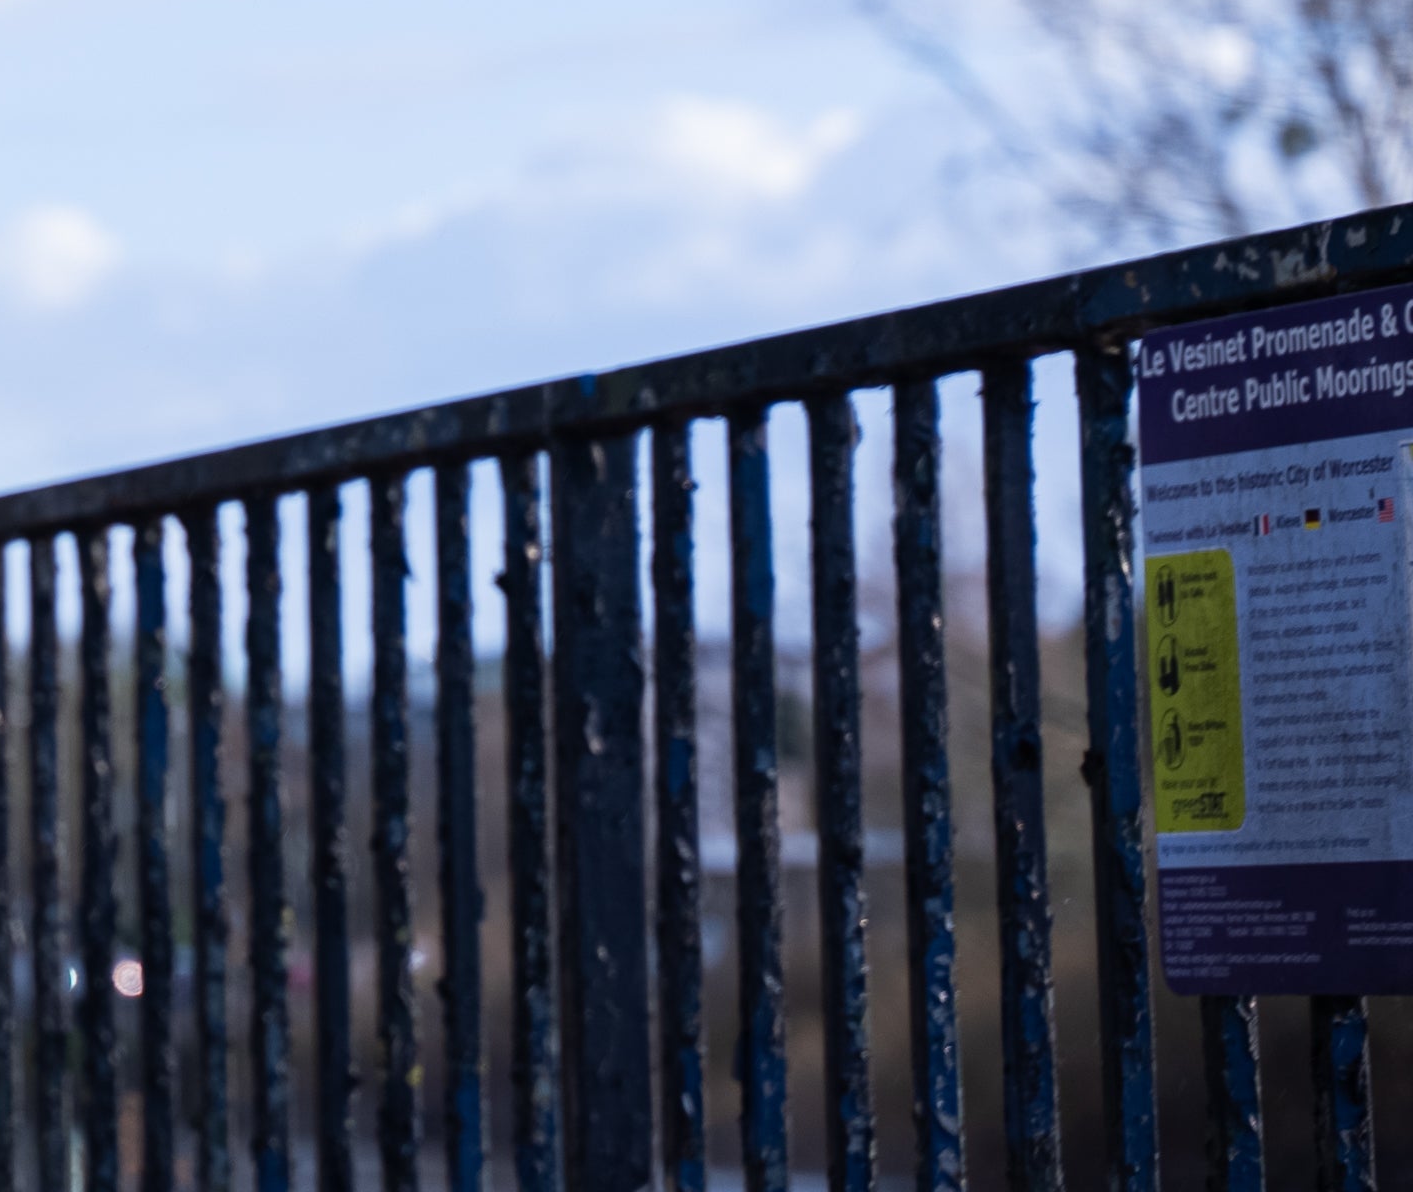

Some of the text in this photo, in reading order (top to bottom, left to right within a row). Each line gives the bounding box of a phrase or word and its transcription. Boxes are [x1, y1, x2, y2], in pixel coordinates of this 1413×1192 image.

[1141, 345, 1166, 379] Le
[1168, 332, 1247, 374] Vesinet
[1251, 307, 1375, 359] Promenade
[1380, 302, 1399, 338] &
[1172, 356, 1413, 422] Centre Public Moorings
[1286, 464, 1311, 487] City
[1314, 459, 1327, 482] of
[1329, 455, 1394, 479] Worcester
